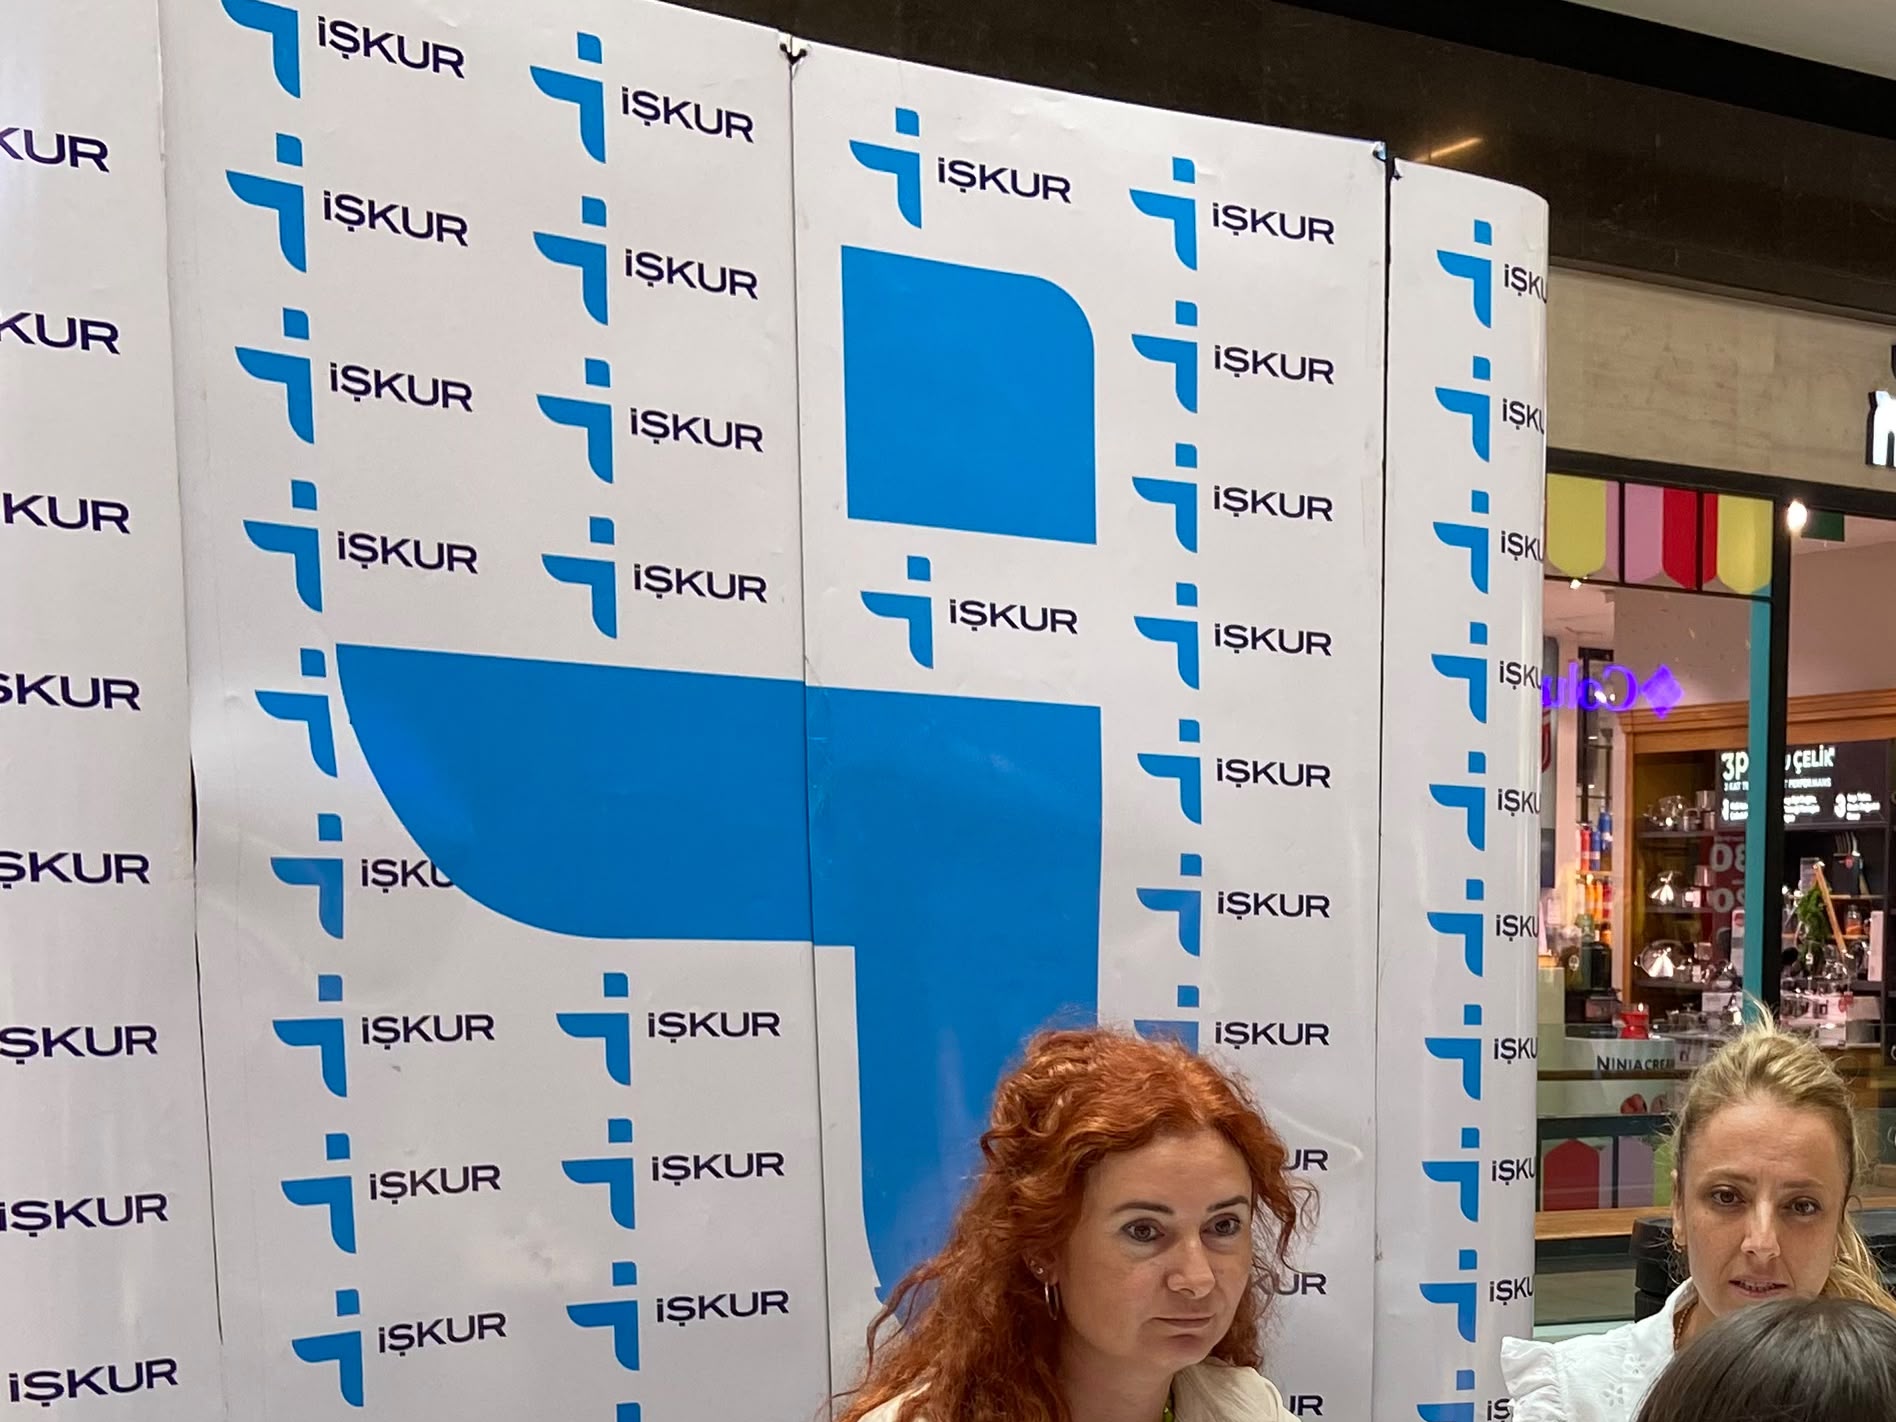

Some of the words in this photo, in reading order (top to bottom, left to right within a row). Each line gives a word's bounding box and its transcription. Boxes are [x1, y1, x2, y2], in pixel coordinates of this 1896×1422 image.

[0, 313, 120, 354] KUR
[3, 493, 130, 534] KUR
[0, 674, 140, 710] KUR
[0, 851, 150, 889] ŞKUR
[0, 1026, 157, 1064] ŞKUR
